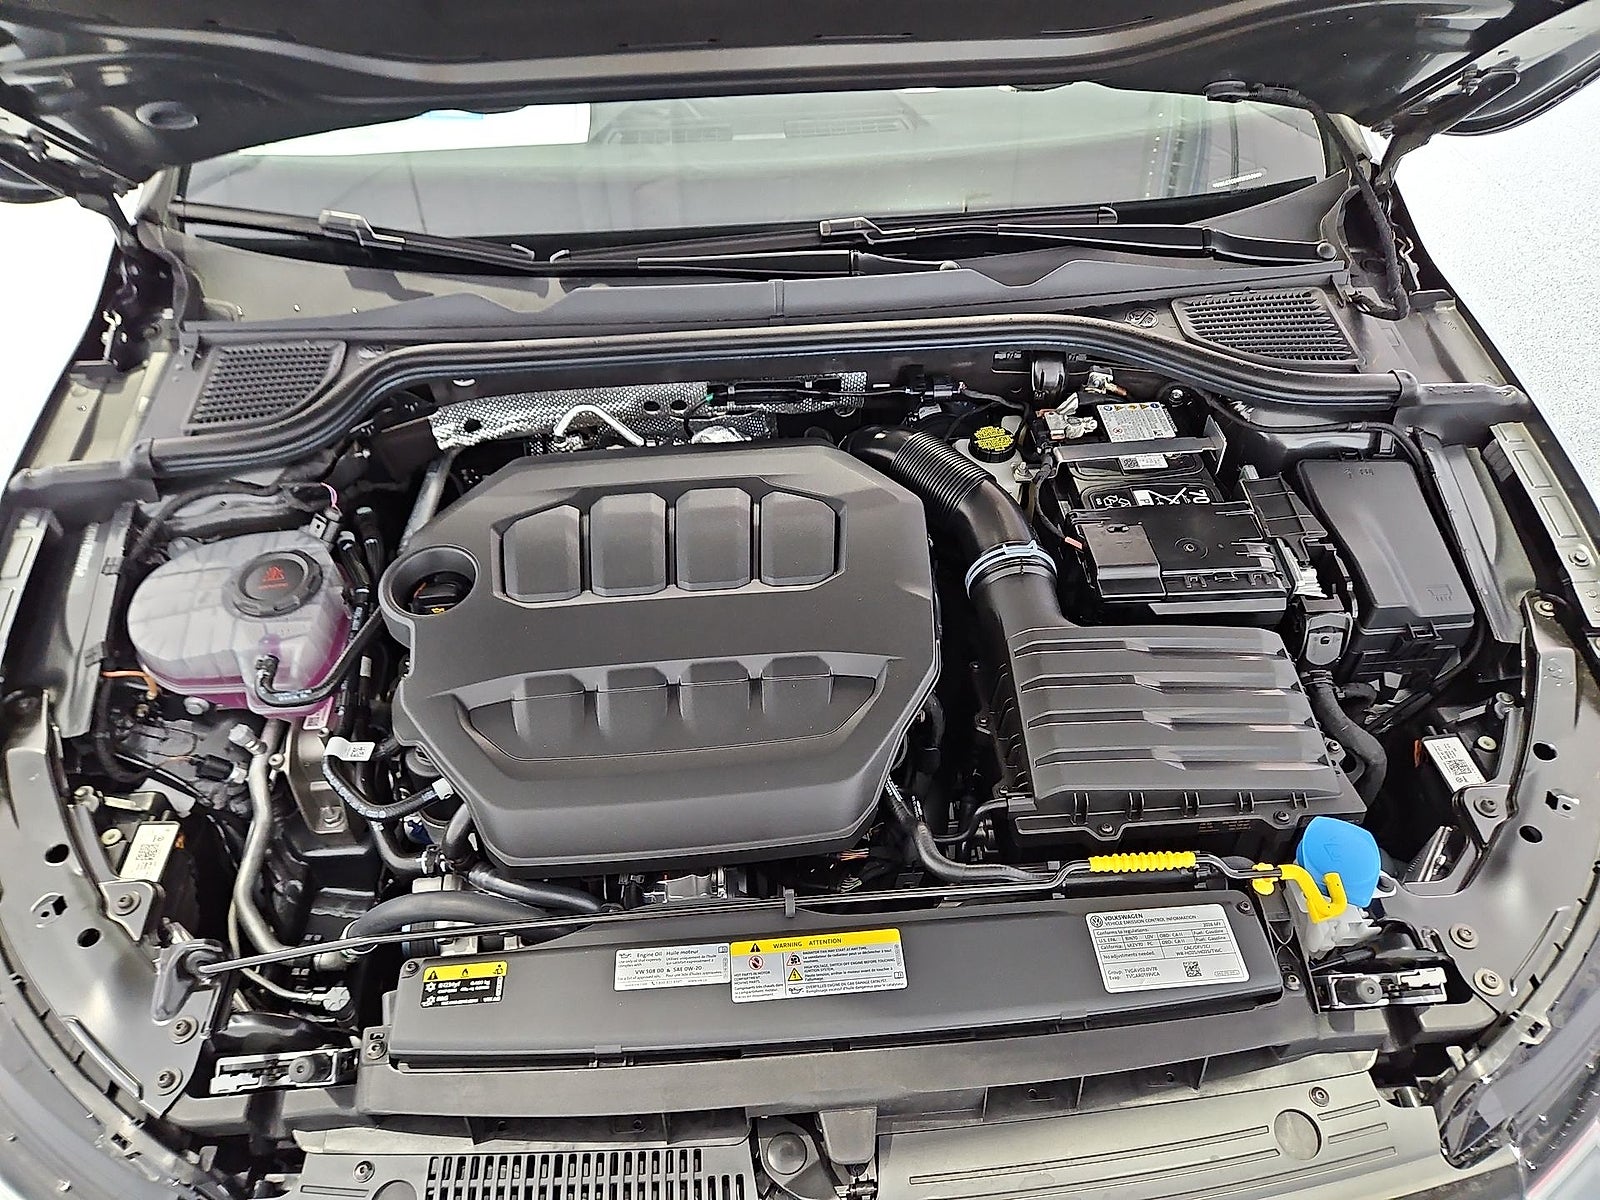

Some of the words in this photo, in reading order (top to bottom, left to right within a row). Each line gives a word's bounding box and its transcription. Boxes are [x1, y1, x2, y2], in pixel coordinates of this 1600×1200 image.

[1103, 913, 1143, 921] VOLKSWAGEN
[809, 938, 842, 946] ATTENTION
[637, 951, 654, 959] Engine
